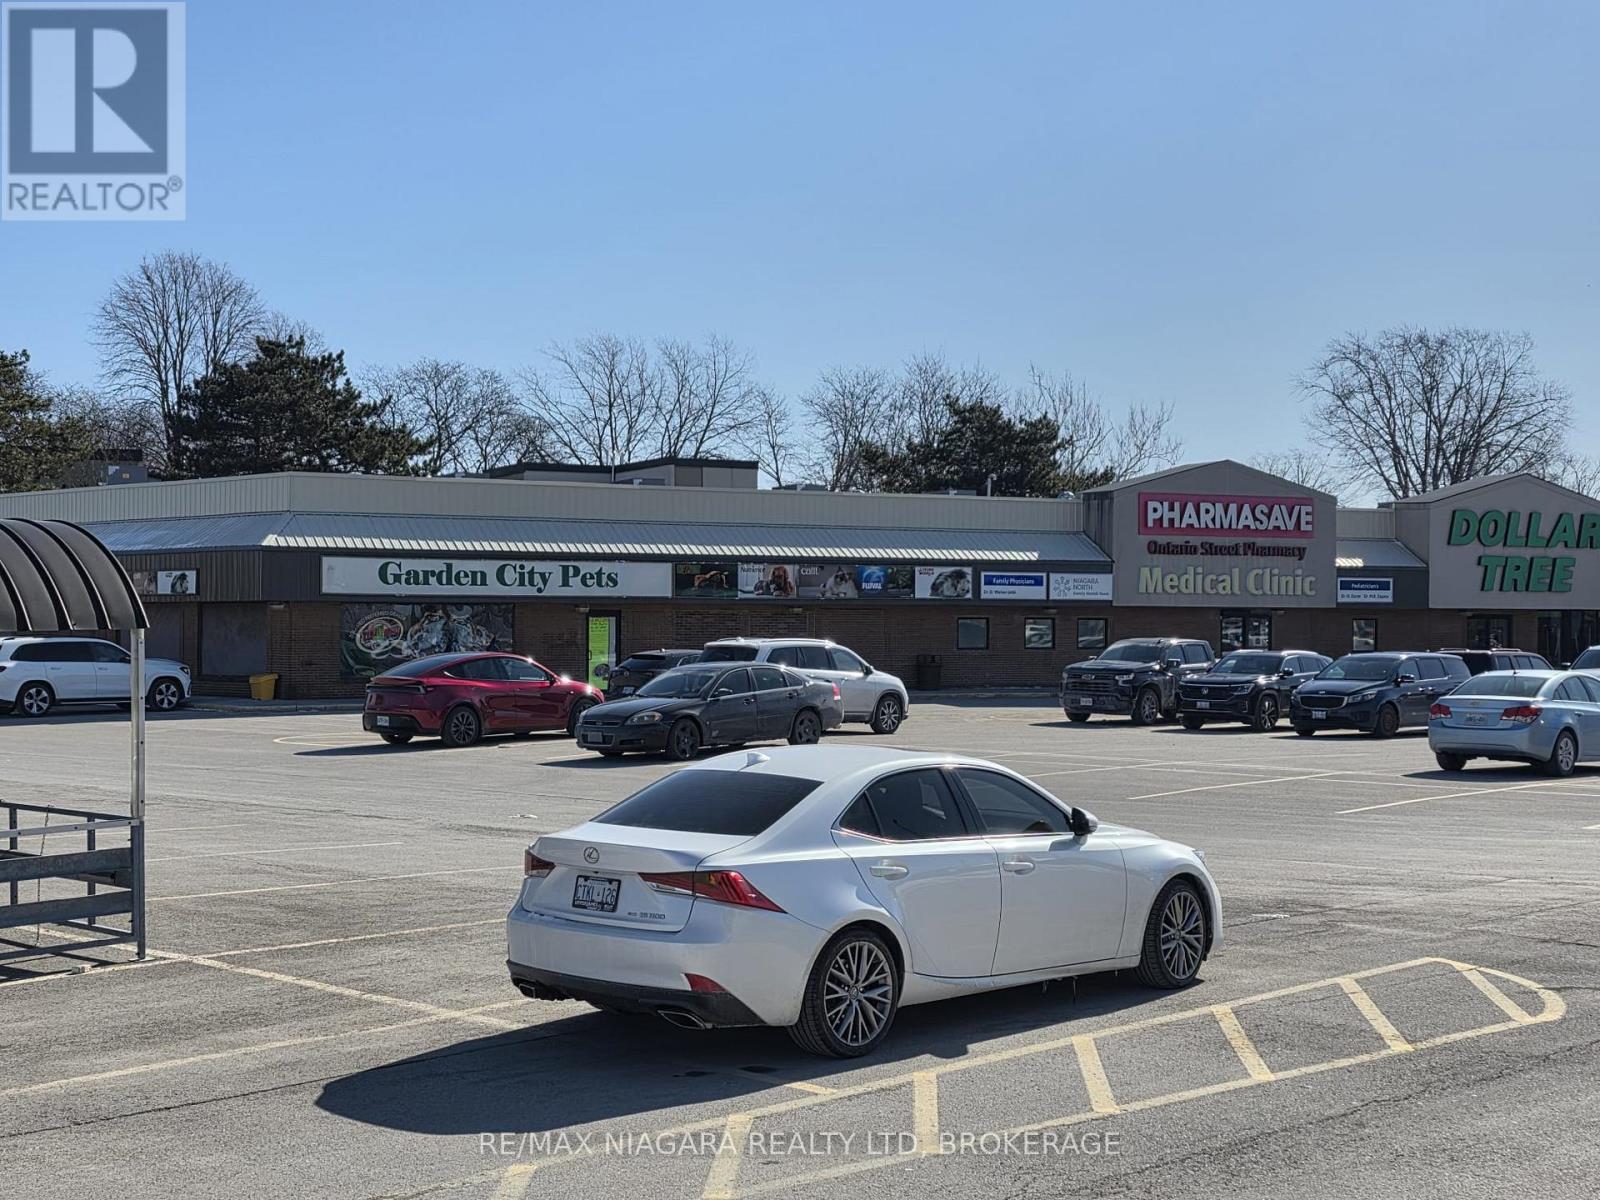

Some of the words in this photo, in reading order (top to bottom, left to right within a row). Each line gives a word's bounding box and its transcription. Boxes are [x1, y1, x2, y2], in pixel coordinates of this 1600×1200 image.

[1147, 500, 1313, 531] PHARMASAVE
[1447, 508, 1600, 549] DOLLAR
[1147, 540, 1198, 556] Ontario
[1200, 541, 1243, 557] Street
[1243, 542, 1307, 561] Pharmacy
[378, 561, 488, 587] Garden
[495, 563, 552, 593] City
[559, 564, 619, 588] Pets
[1138, 565, 1242, 595] Medical
[1246, 568, 1317, 597] Clinic
[1478, 555, 1576, 593] TREE
